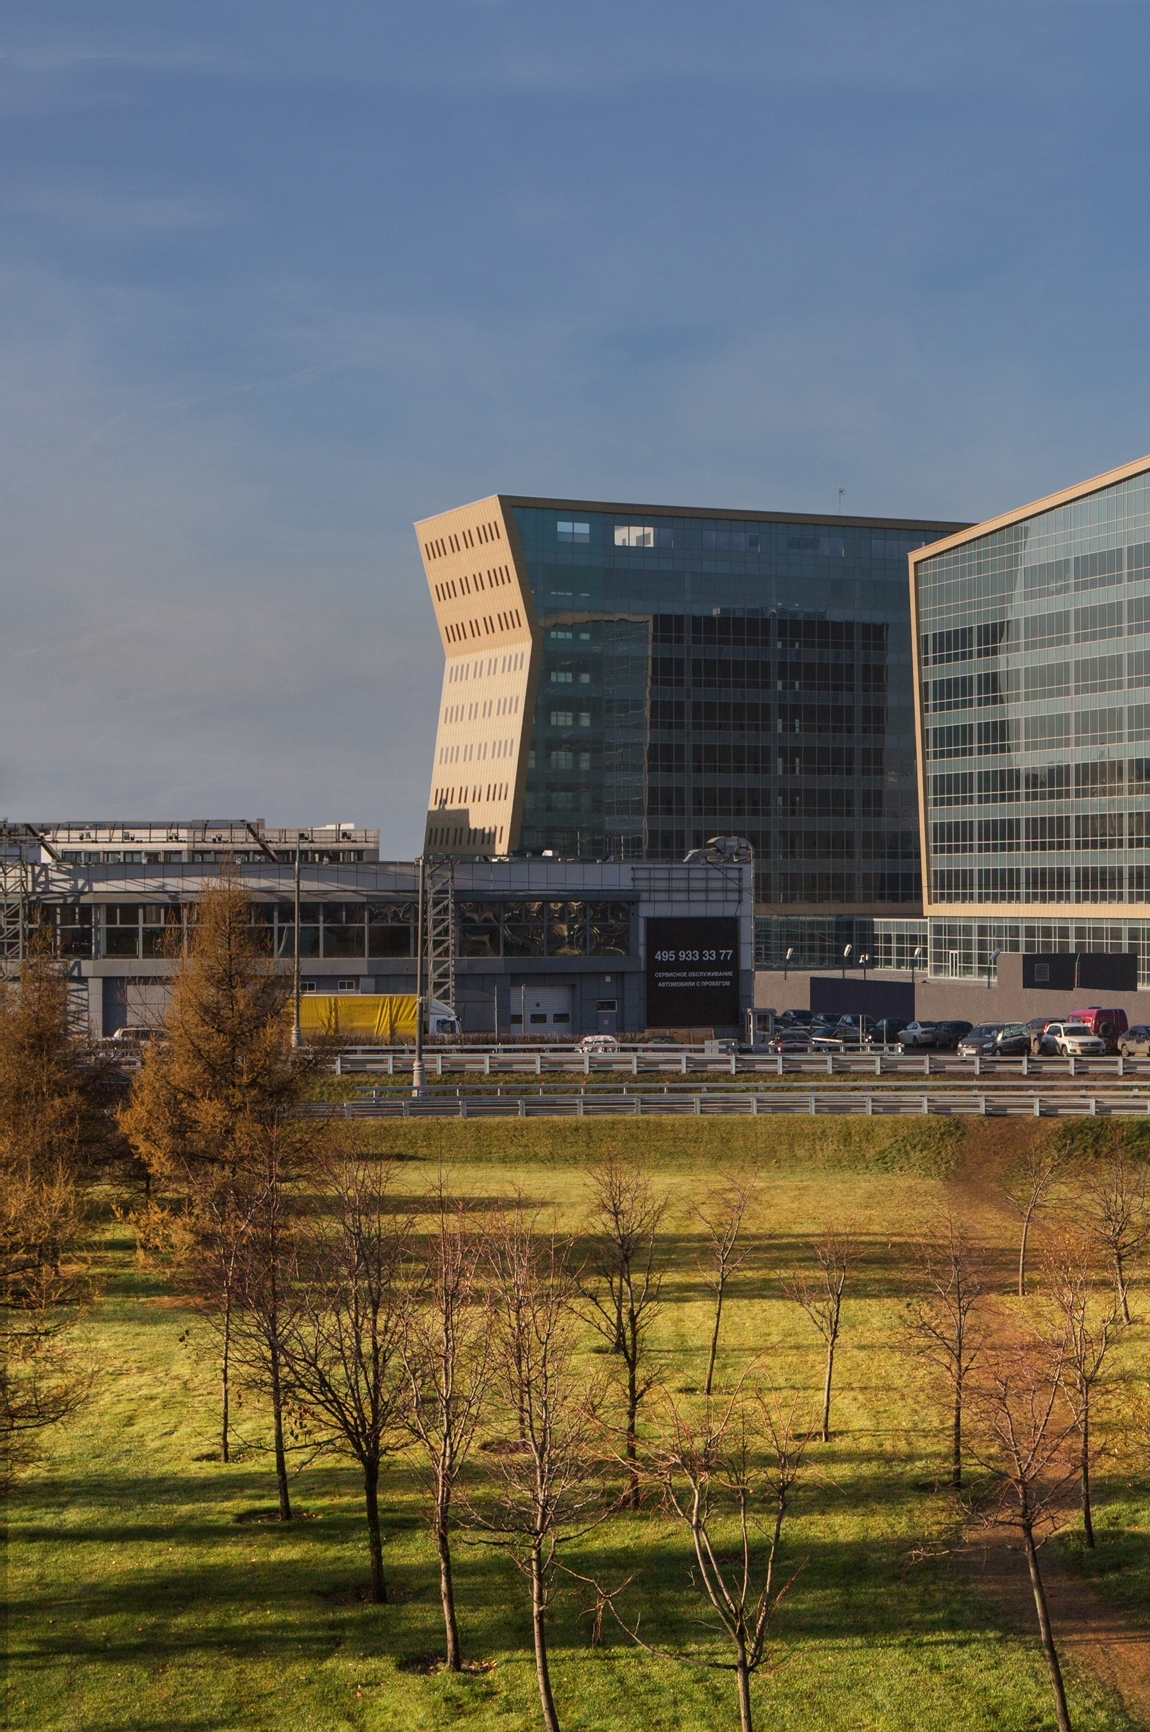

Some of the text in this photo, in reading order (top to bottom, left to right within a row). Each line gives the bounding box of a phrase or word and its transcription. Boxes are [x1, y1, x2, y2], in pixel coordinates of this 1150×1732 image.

[654, 950, 733, 961] 495 933 33 77
